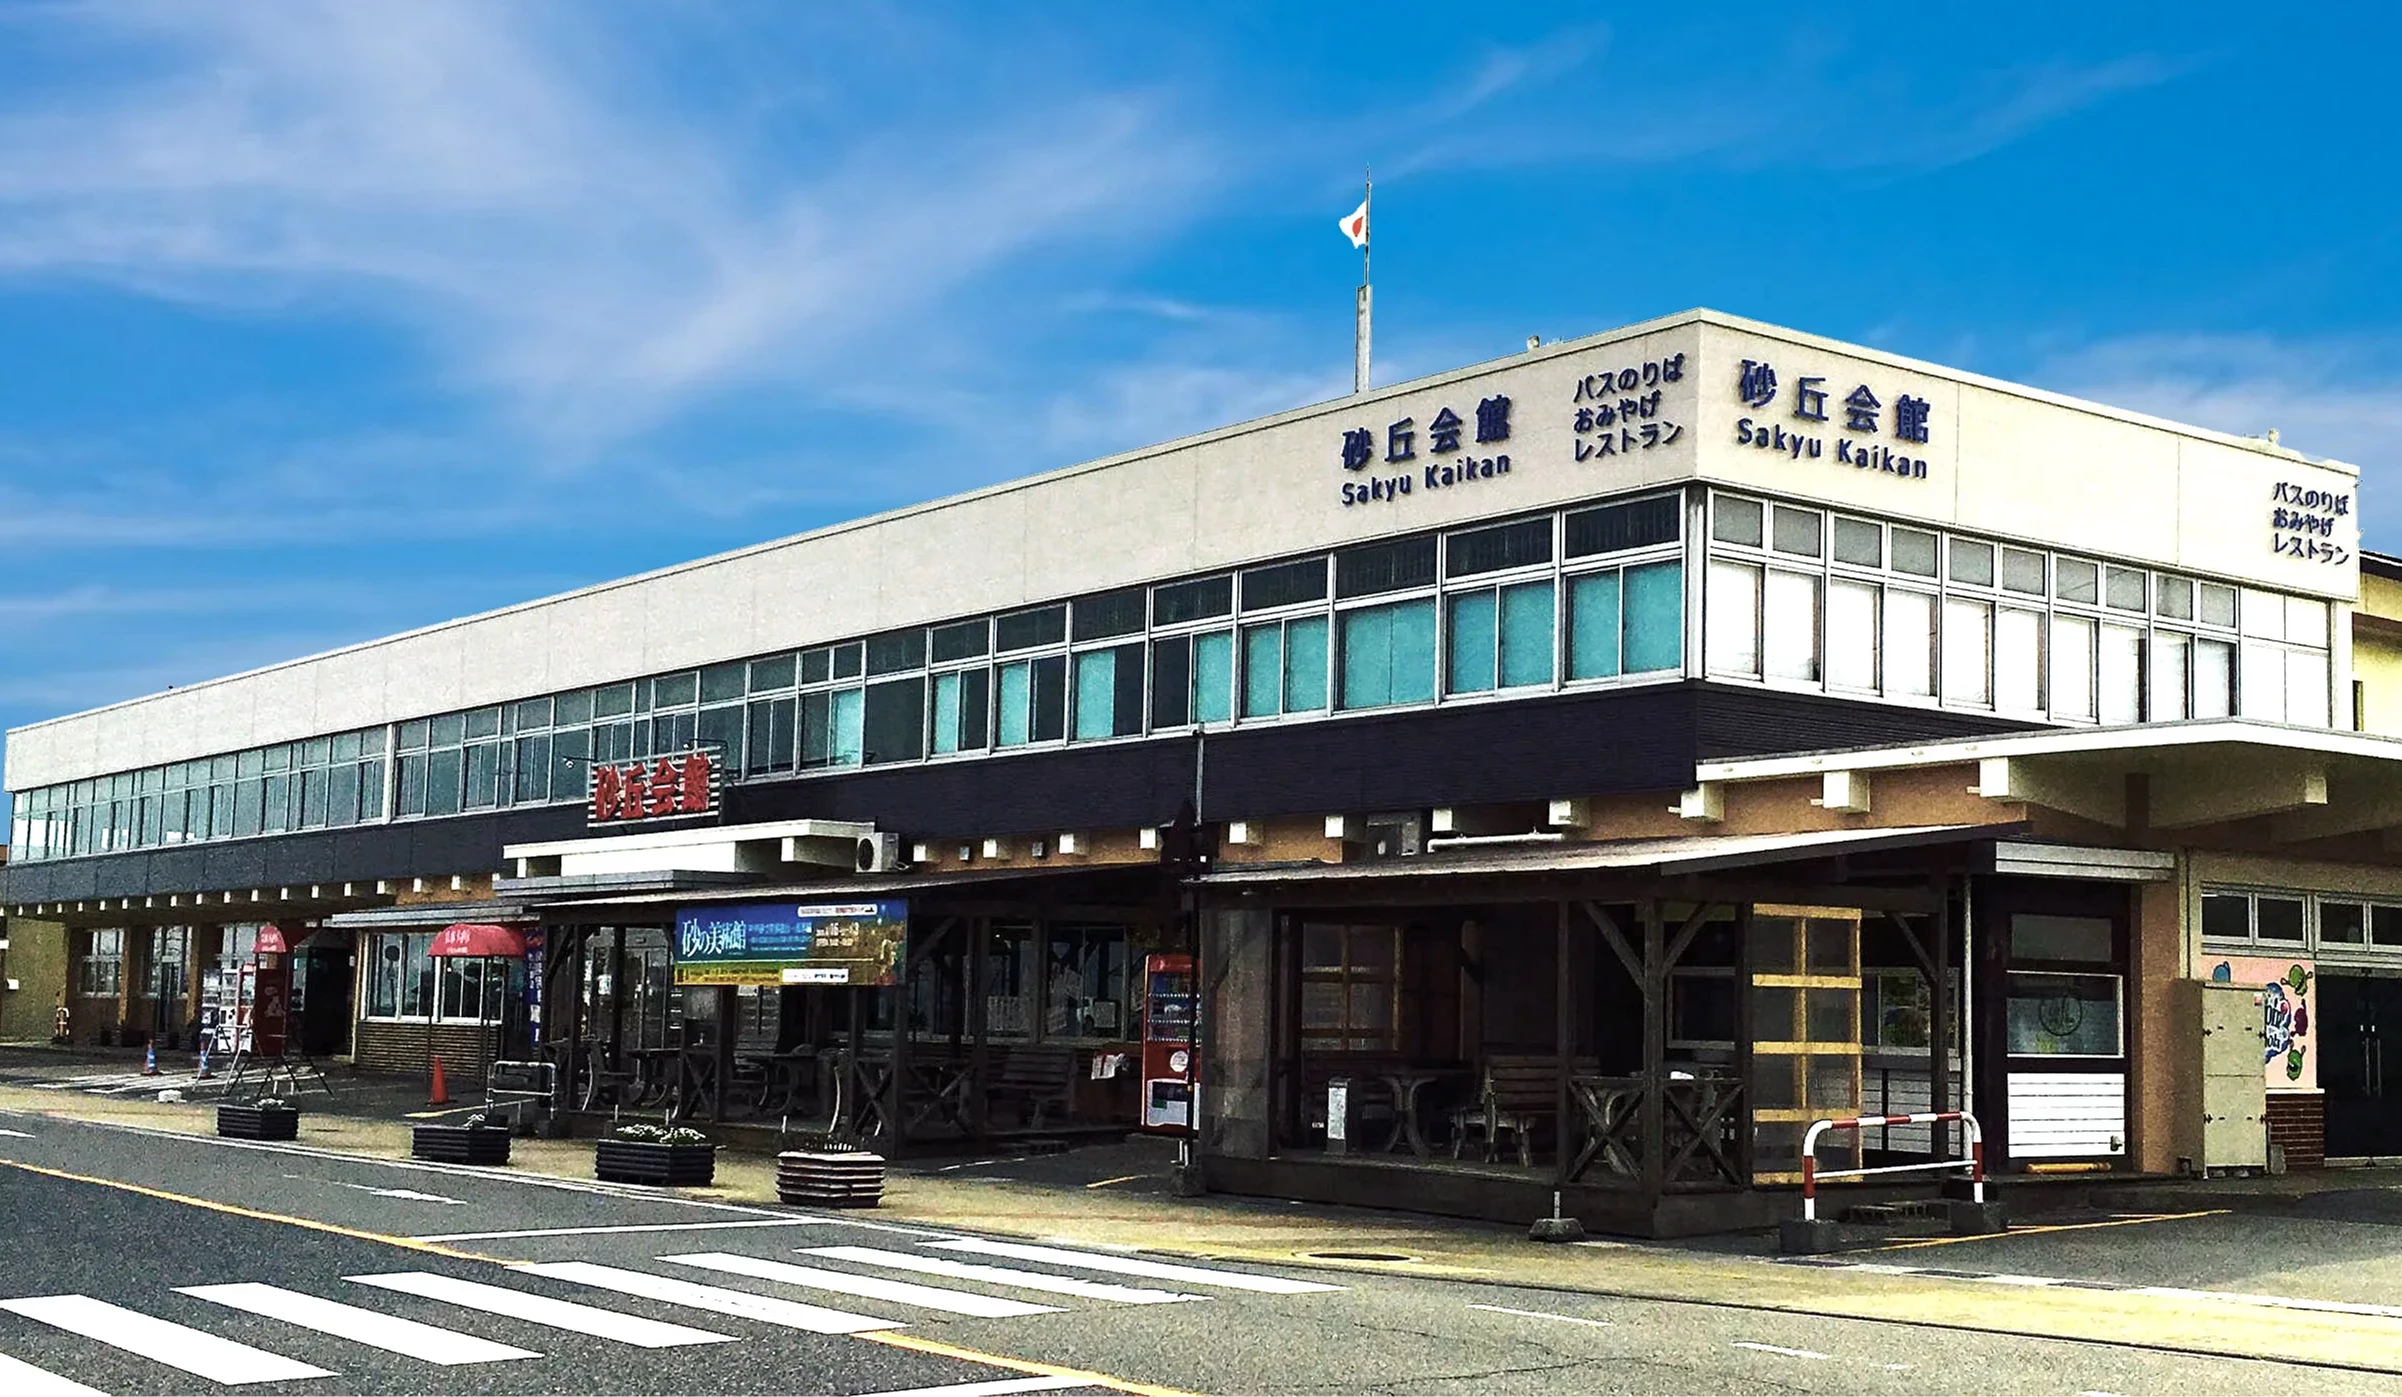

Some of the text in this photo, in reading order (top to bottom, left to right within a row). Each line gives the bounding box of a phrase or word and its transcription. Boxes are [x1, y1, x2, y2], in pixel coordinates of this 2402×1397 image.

[1573, 352, 1685, 403] バスのりば
[1740, 359, 1930, 443] 砂丘会館
[1341, 394, 1512, 471] 砂丘会館
[1573, 389, 1662, 433] おみやげ
[1575, 421, 1684, 462] レストラン
[1737, 417, 1927, 479] Sakyu Kaikan
[1341, 454, 1511, 505] Sakyu Kaikan
[2273, 481, 2349, 516] バスのりば
[2272, 507, 2335, 538] おみやげ
[2274, 532, 2350, 565] レストラン
[595, 752, 710, 821] 砂丘会館
[682, 918, 747, 957] 砂の美術館
